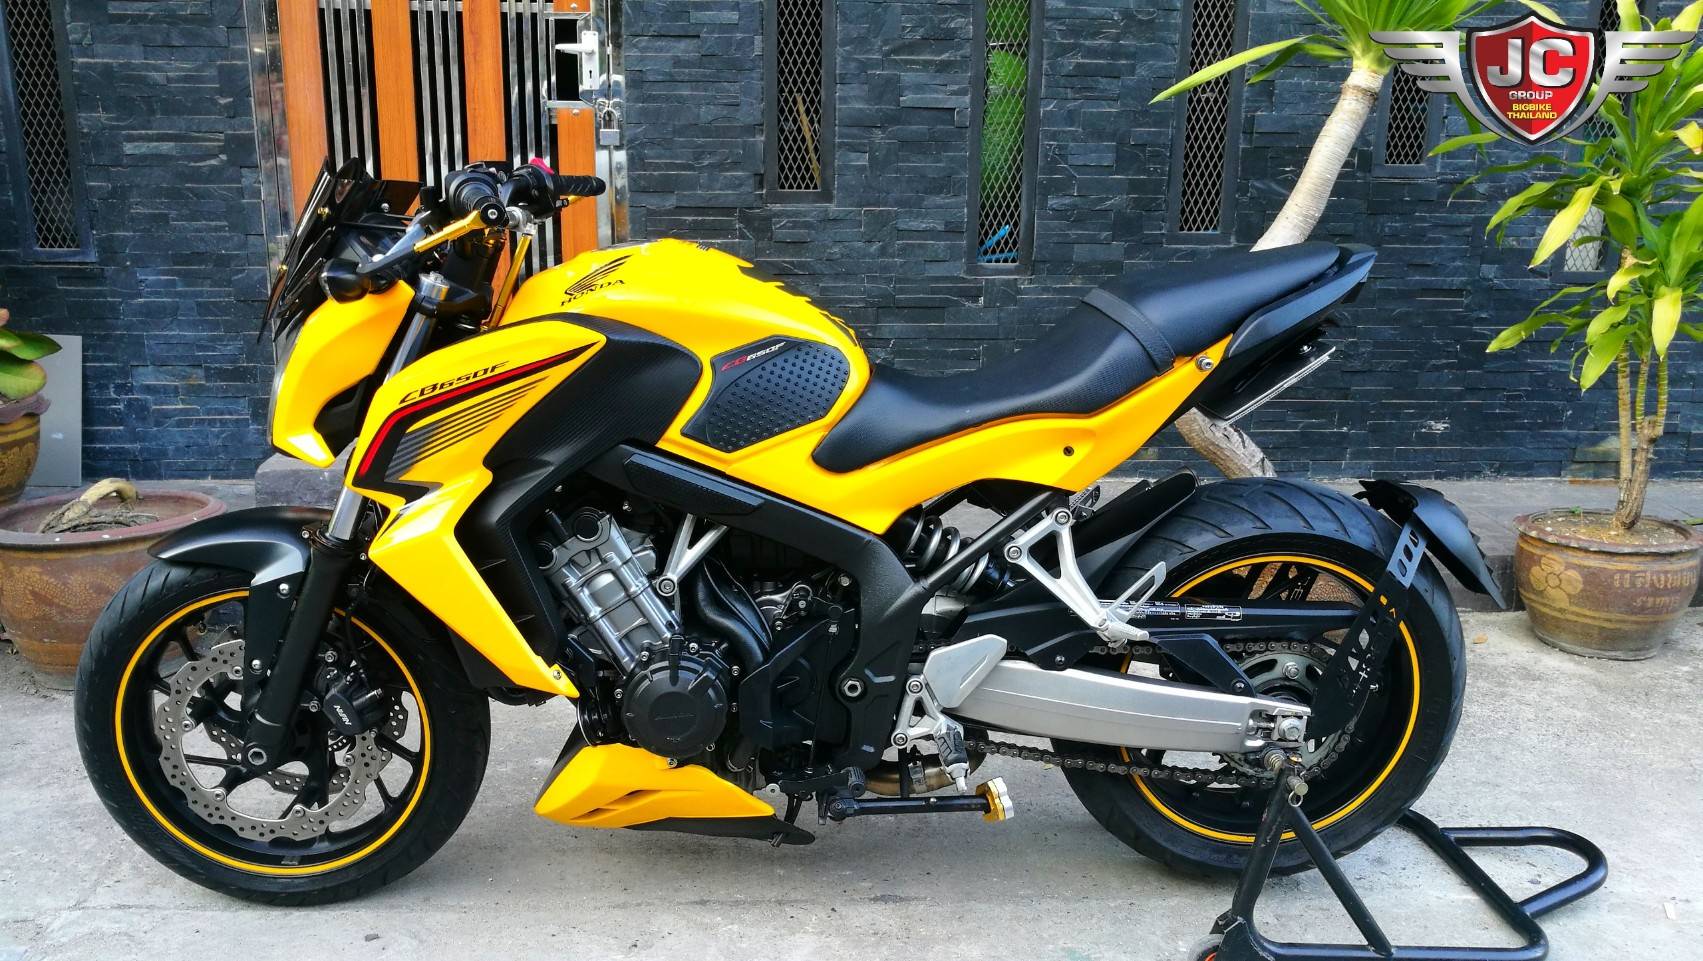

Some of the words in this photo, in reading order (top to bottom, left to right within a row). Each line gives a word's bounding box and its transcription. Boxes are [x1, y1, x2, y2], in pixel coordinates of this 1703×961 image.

[560, 279, 625, 307] HONDA
[721, 341, 787, 372] CB650F
[398, 360, 510, 405] CB650F
